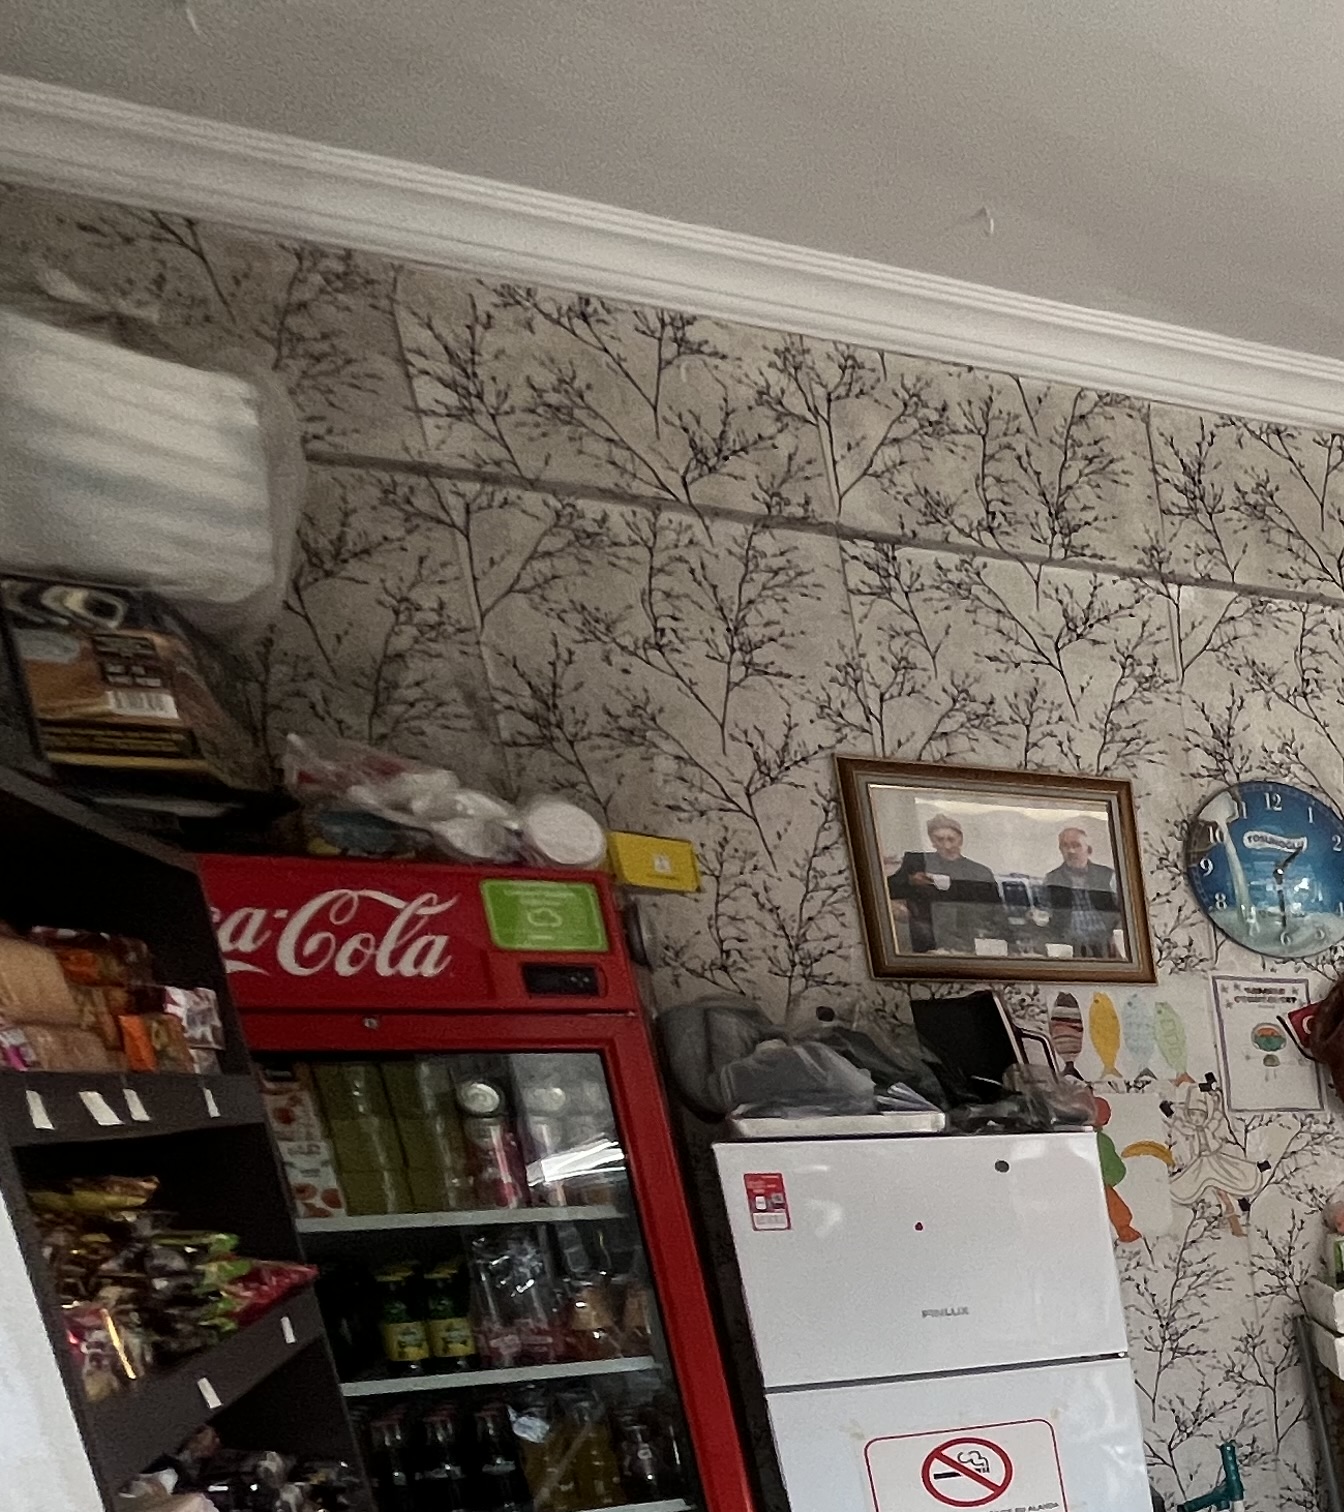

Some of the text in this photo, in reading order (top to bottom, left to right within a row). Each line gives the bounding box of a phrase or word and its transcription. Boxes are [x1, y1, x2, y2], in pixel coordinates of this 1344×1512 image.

[1264, 792, 1283, 811] 12
[1332, 835, 1343, 852] 2
[1200, 857, 1214, 877] 9
[1214, 892, 1228, 910] 8
